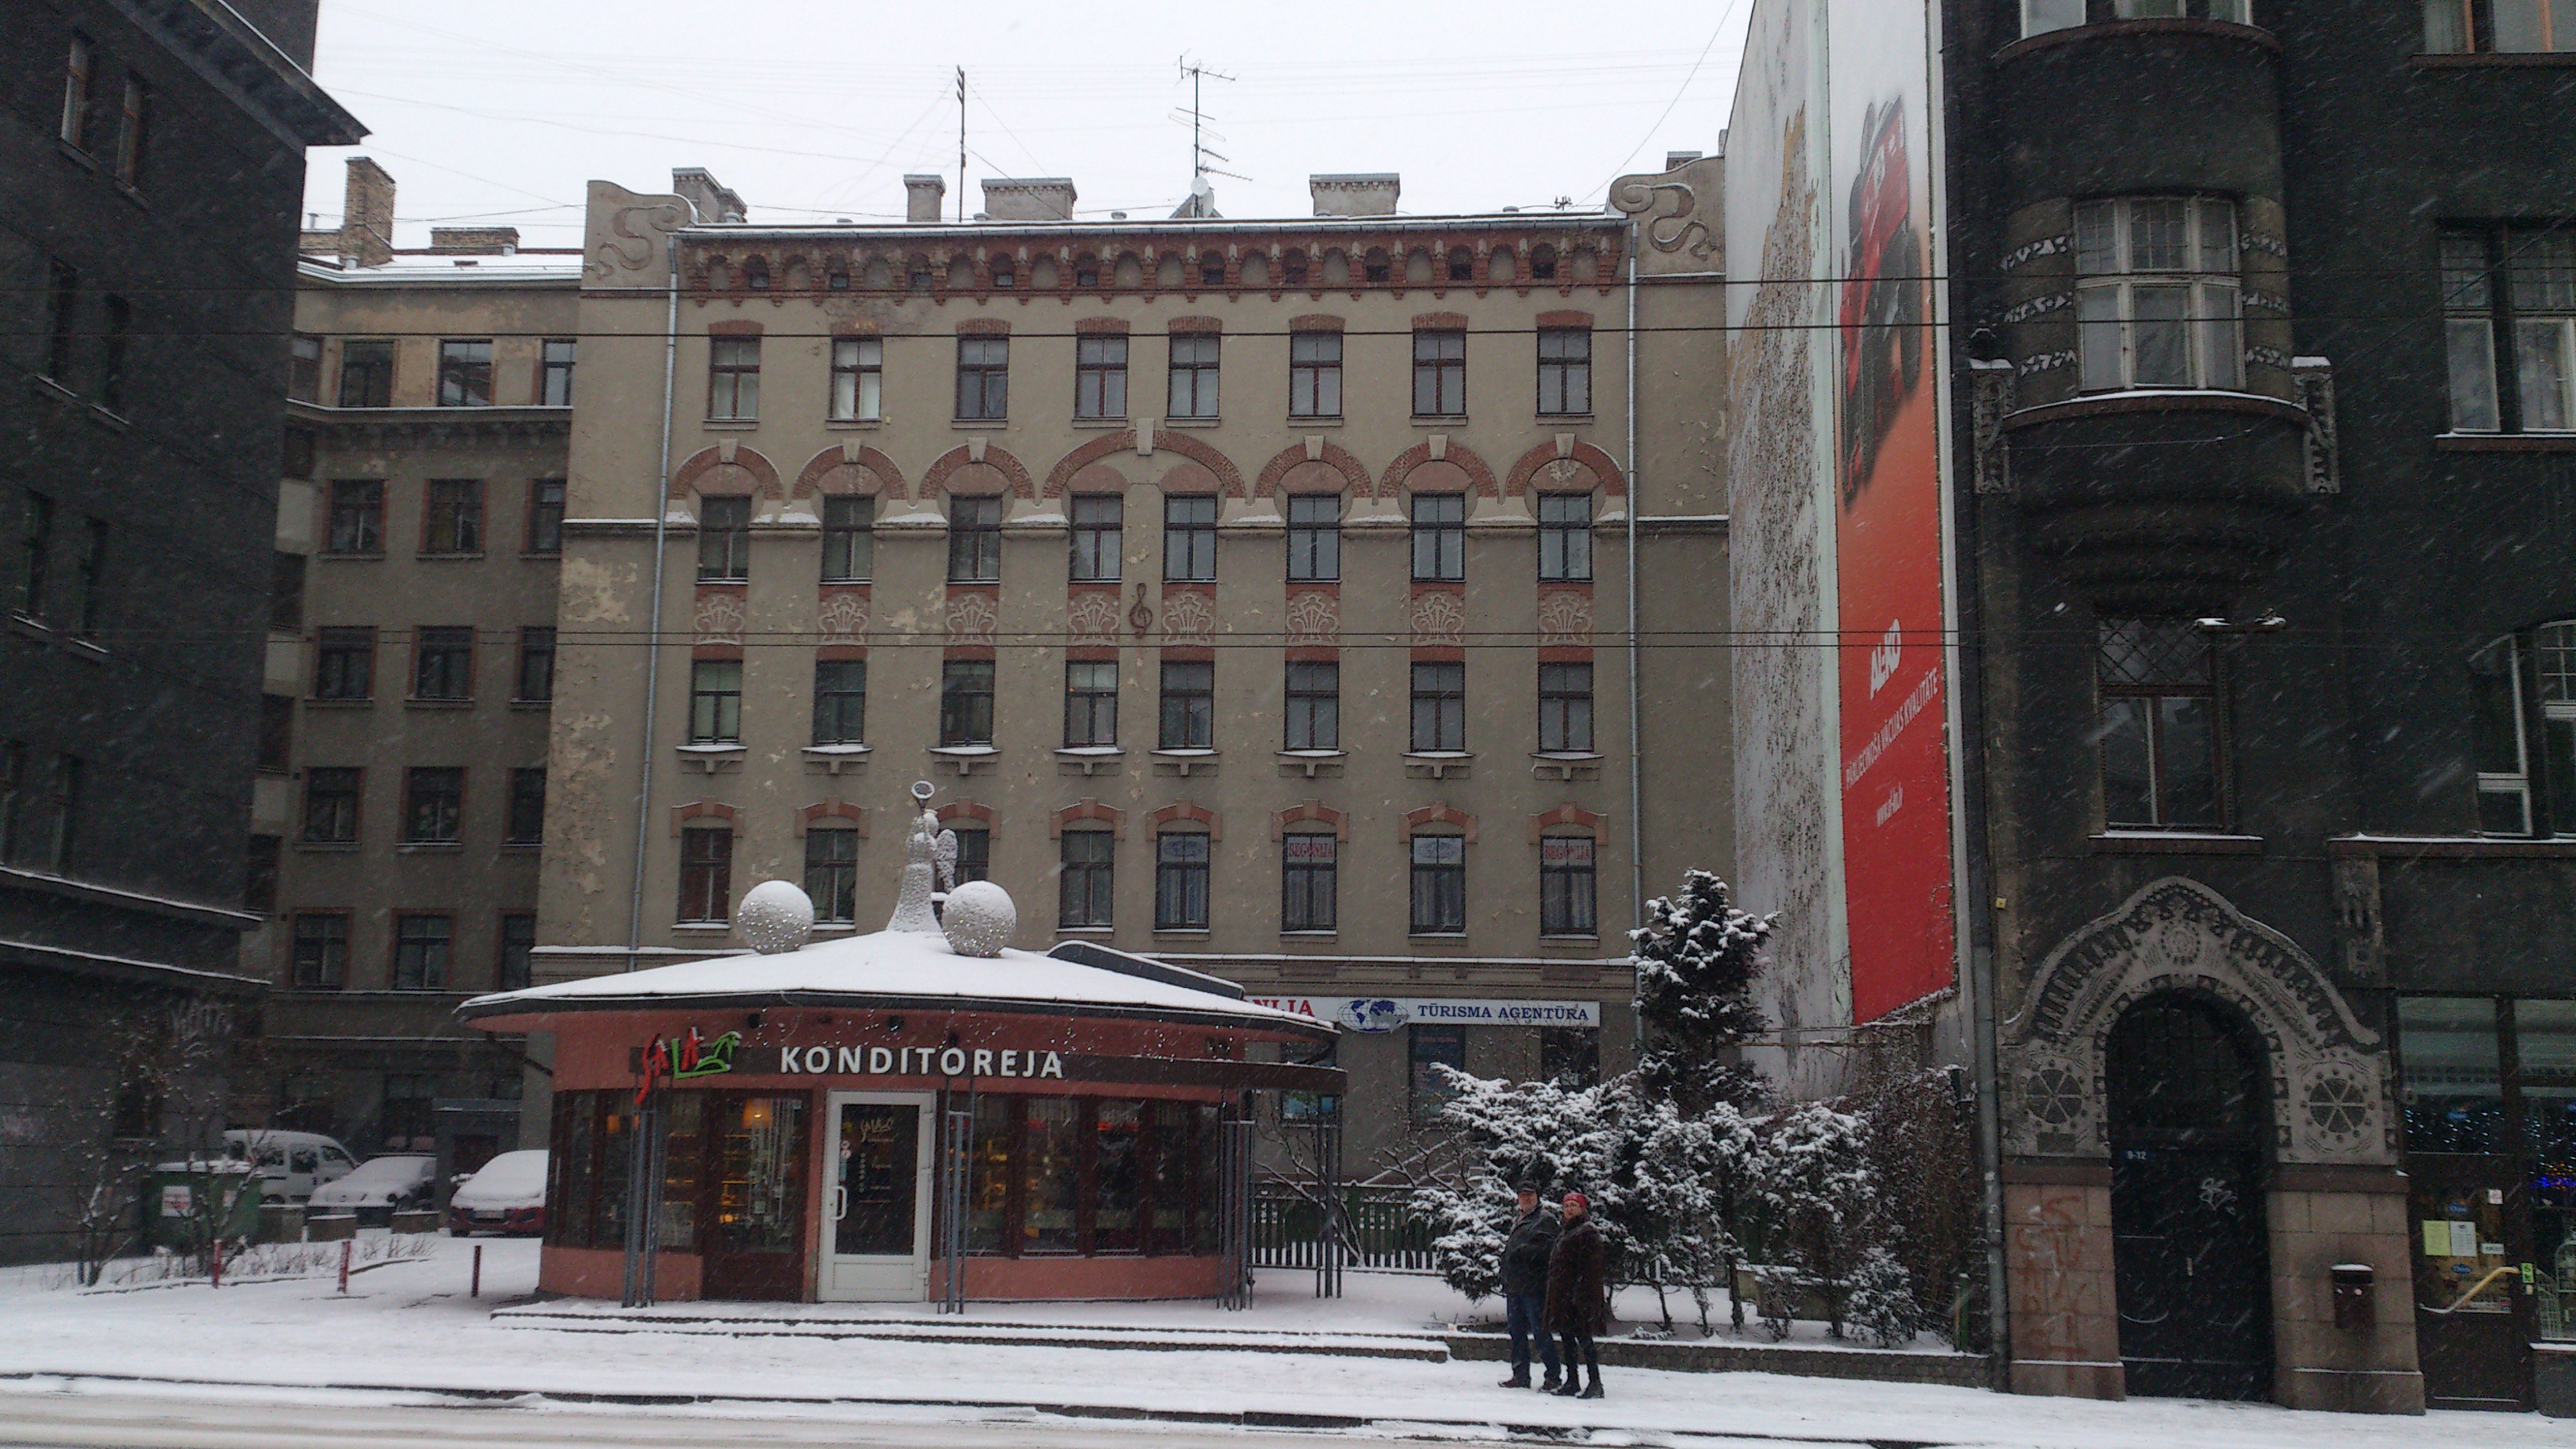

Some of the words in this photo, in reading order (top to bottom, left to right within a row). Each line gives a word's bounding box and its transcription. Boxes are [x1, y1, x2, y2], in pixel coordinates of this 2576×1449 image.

[1870, 618, 1902, 700] AL-KO
[1904, 667, 1938, 726] KVALITĀTE
[1417, 1003, 1492, 1018] TŪRISMA
[1498, 1005, 1589, 1020] AGENTŪRA
[780, 1046, 1063, 1079] KONDITOREJA
